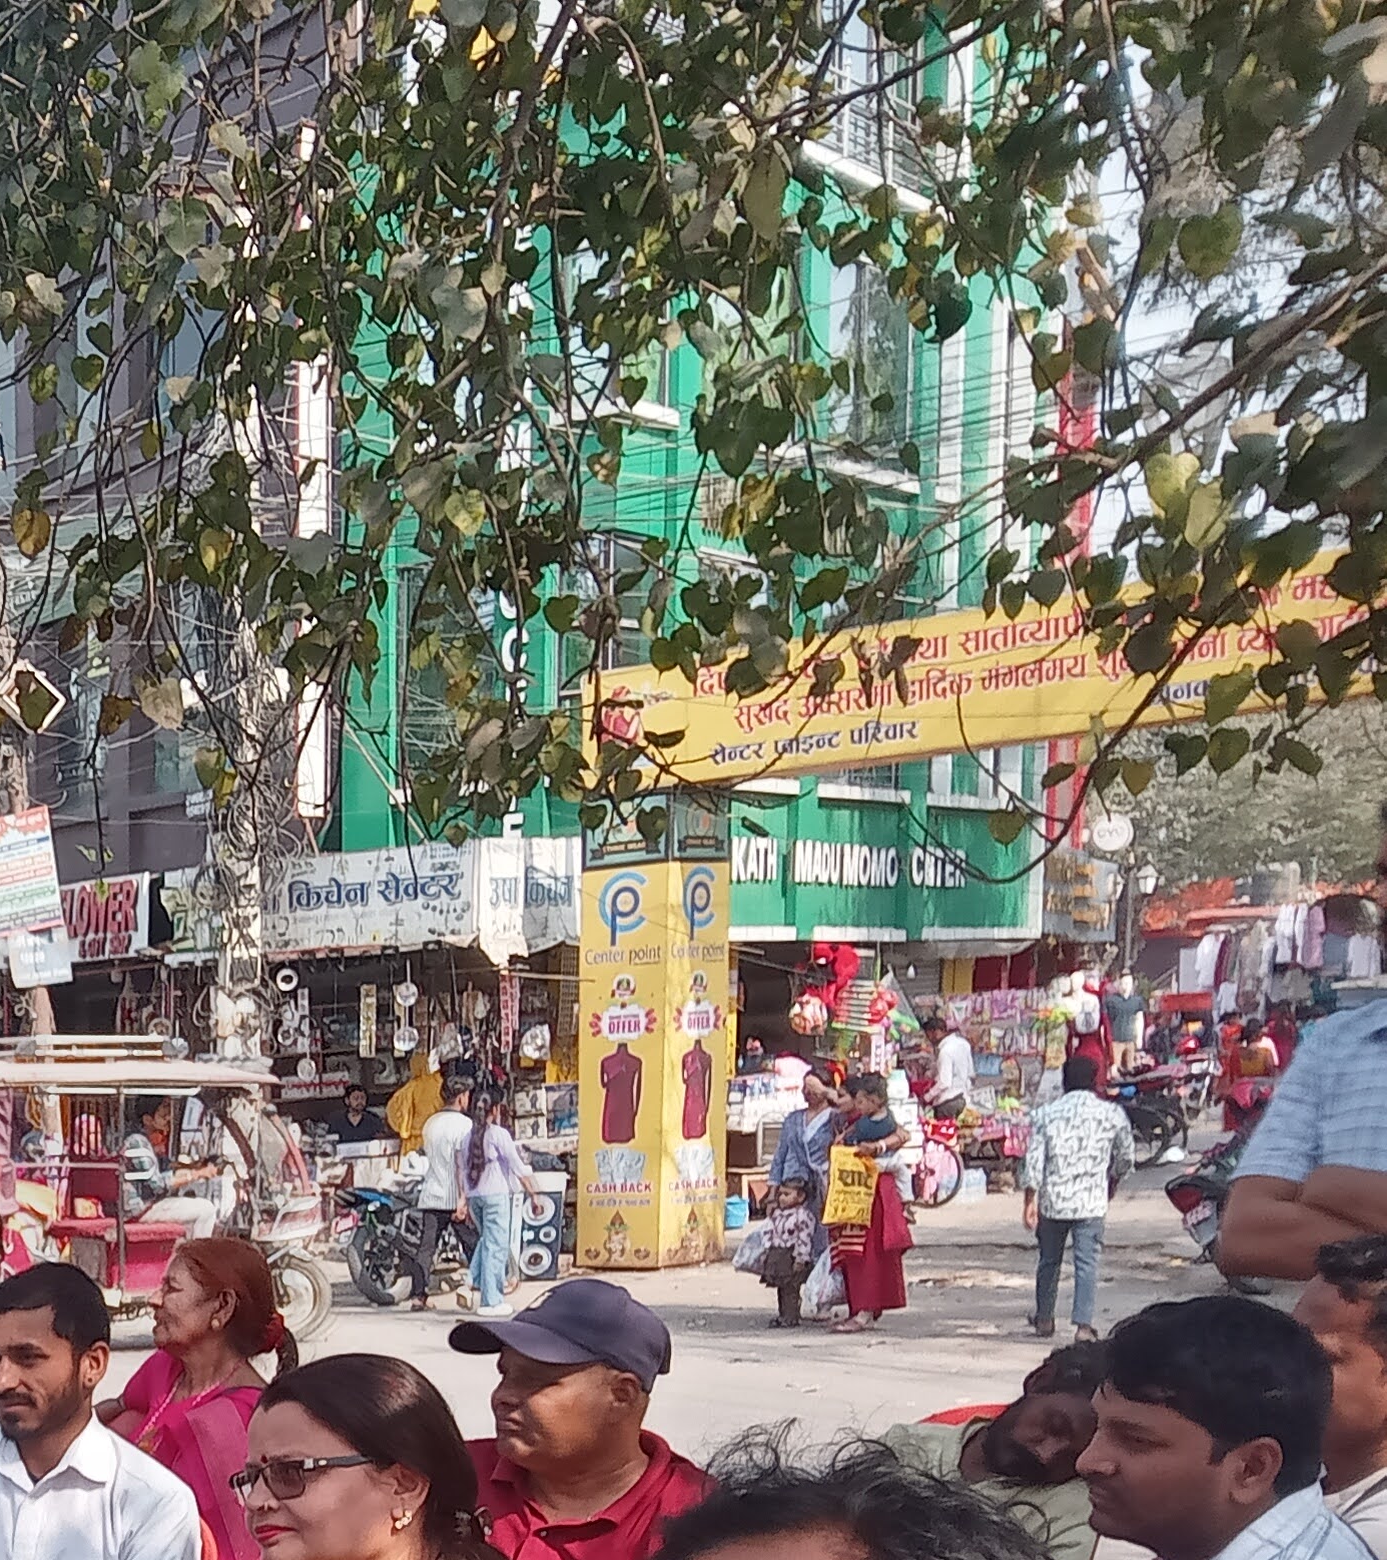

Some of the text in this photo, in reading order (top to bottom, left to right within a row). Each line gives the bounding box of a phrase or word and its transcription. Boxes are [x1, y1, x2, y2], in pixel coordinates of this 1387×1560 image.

[711, 741, 765, 766] सेन्टर
[850, 719, 921, 745] परिवार
[731, 836, 778, 883] KATH
[288, 876, 369, 913] किचेन
[60, 879, 140, 940] LOWER
[585, 943, 662, 966] Center point
[702, 942, 725, 962] point
[608, 1018, 641, 1035] OFFER
[687, 1013, 711, 1030] OFFER
[586, 1182, 652, 1194] CASH BACK
[695, 1178, 719, 1190] BACK
